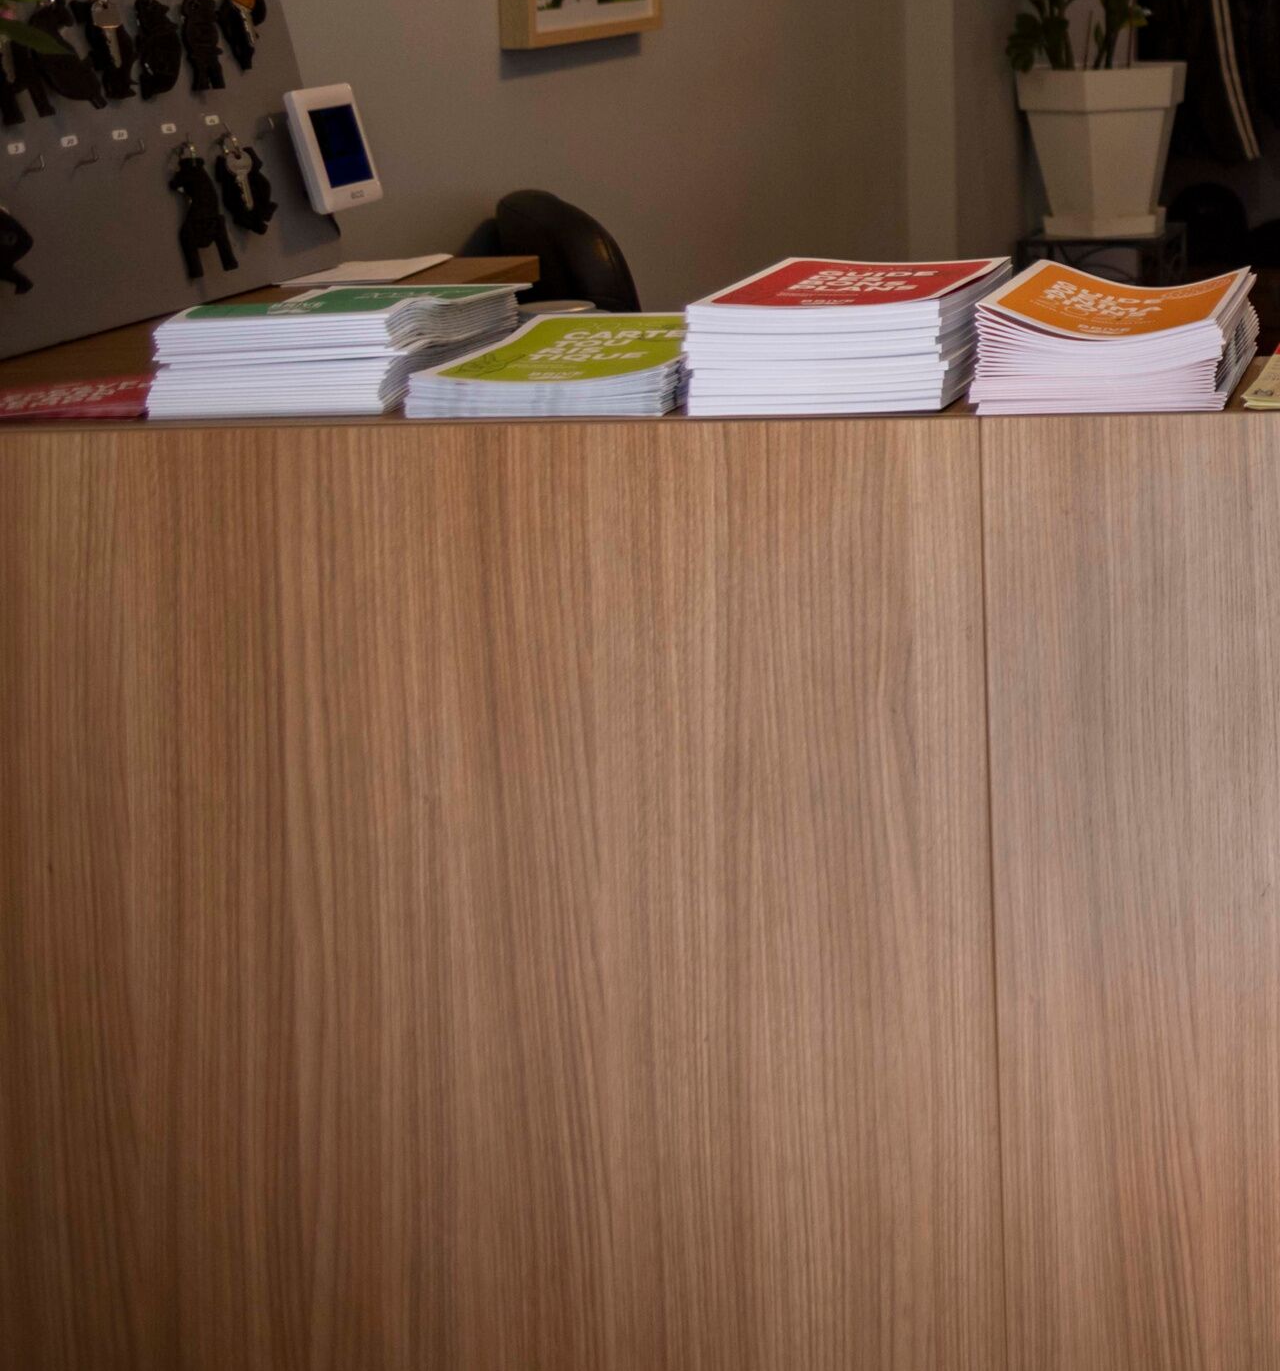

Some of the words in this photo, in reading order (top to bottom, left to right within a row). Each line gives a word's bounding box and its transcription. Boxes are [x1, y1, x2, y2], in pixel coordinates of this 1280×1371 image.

[816, 269, 940, 278] GUIDE
[797, 280, 908, 288] BONS
[562, 329, 685, 340] CARTE
[553, 339, 635, 348] TOU
[528, 351, 649, 362] TIQUE
